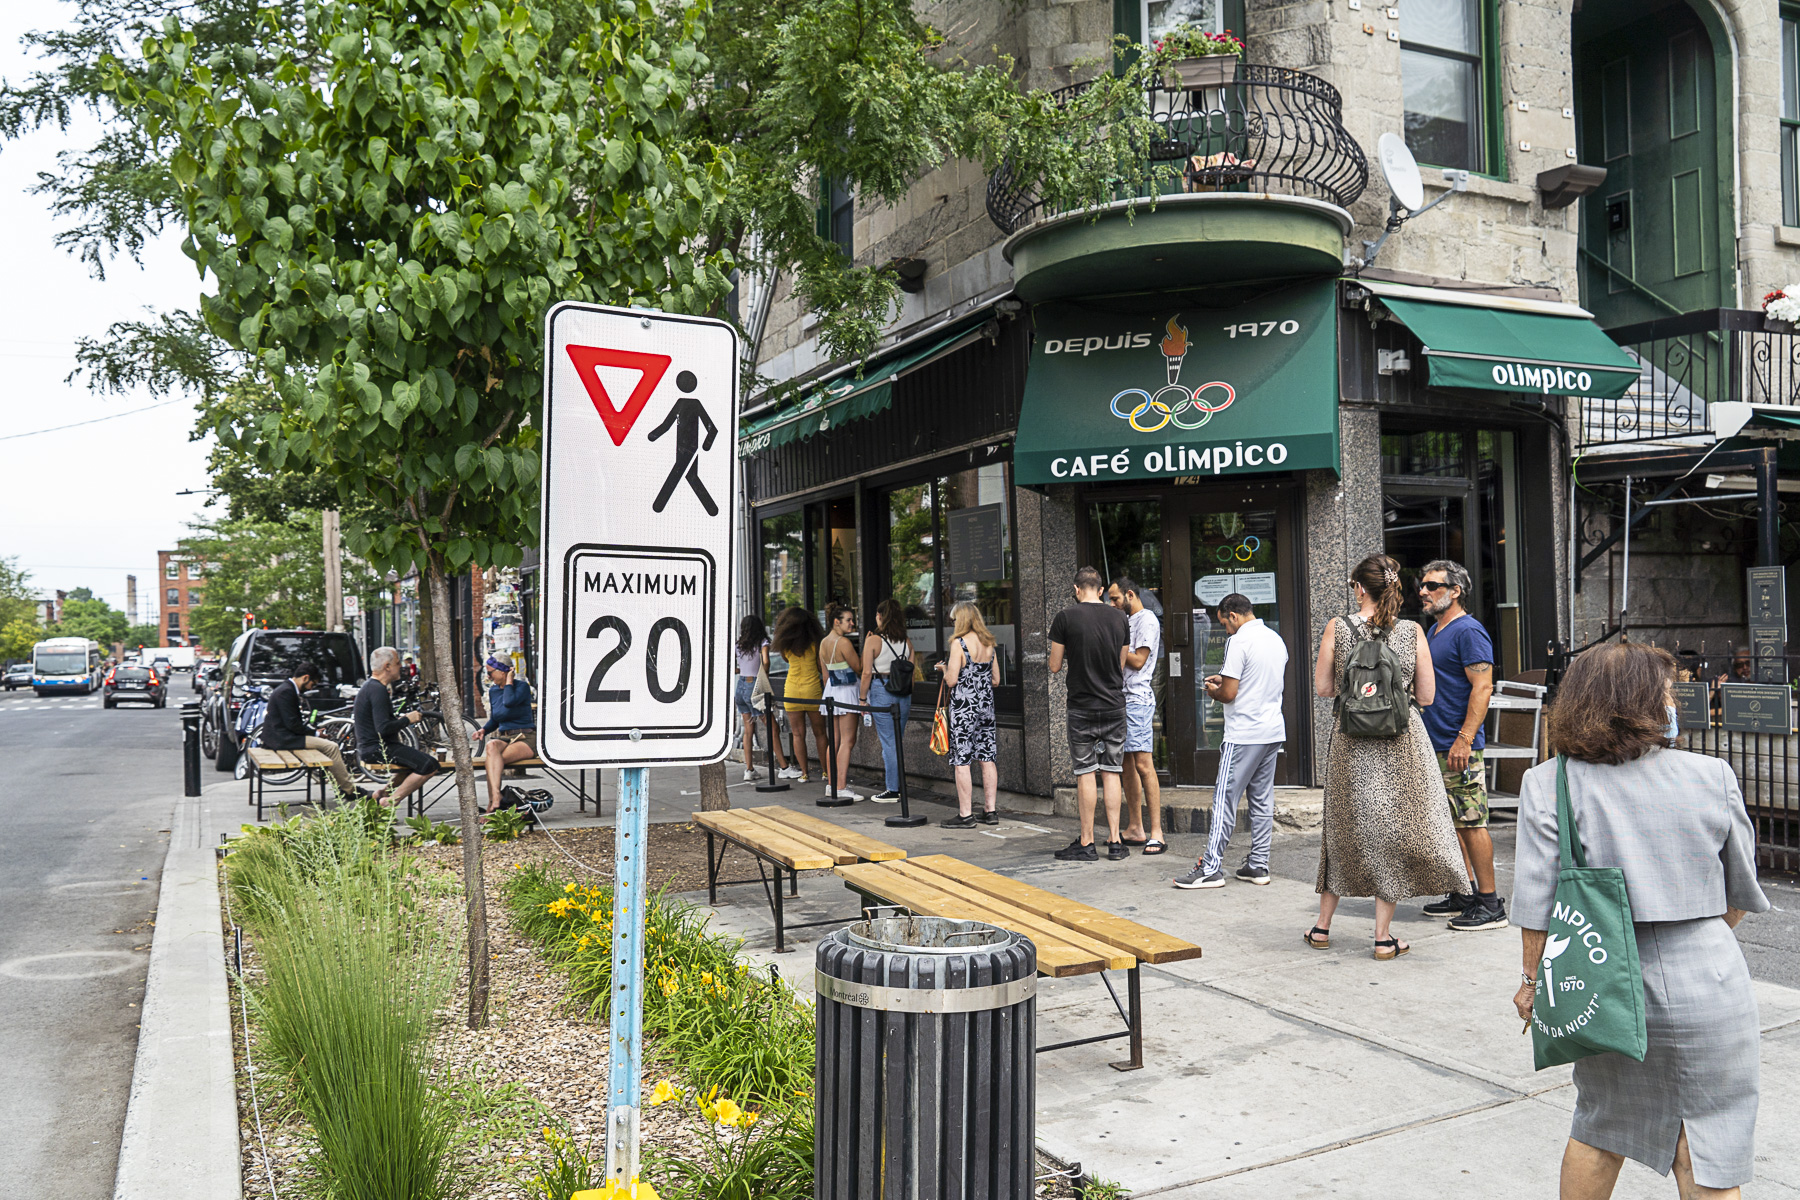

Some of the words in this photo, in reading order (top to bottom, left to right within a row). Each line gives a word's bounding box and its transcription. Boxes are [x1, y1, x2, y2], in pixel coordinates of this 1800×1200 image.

[1223, 319, 1300, 339] 1970
[584, 571, 697, 596] MAXIMUM
[585, 615, 692, 704] 20
[830, 986, 858, 1002] Montréal
[1559, 980, 1585, 992] 1970
[1550, 1026, 1565, 1038] DA
